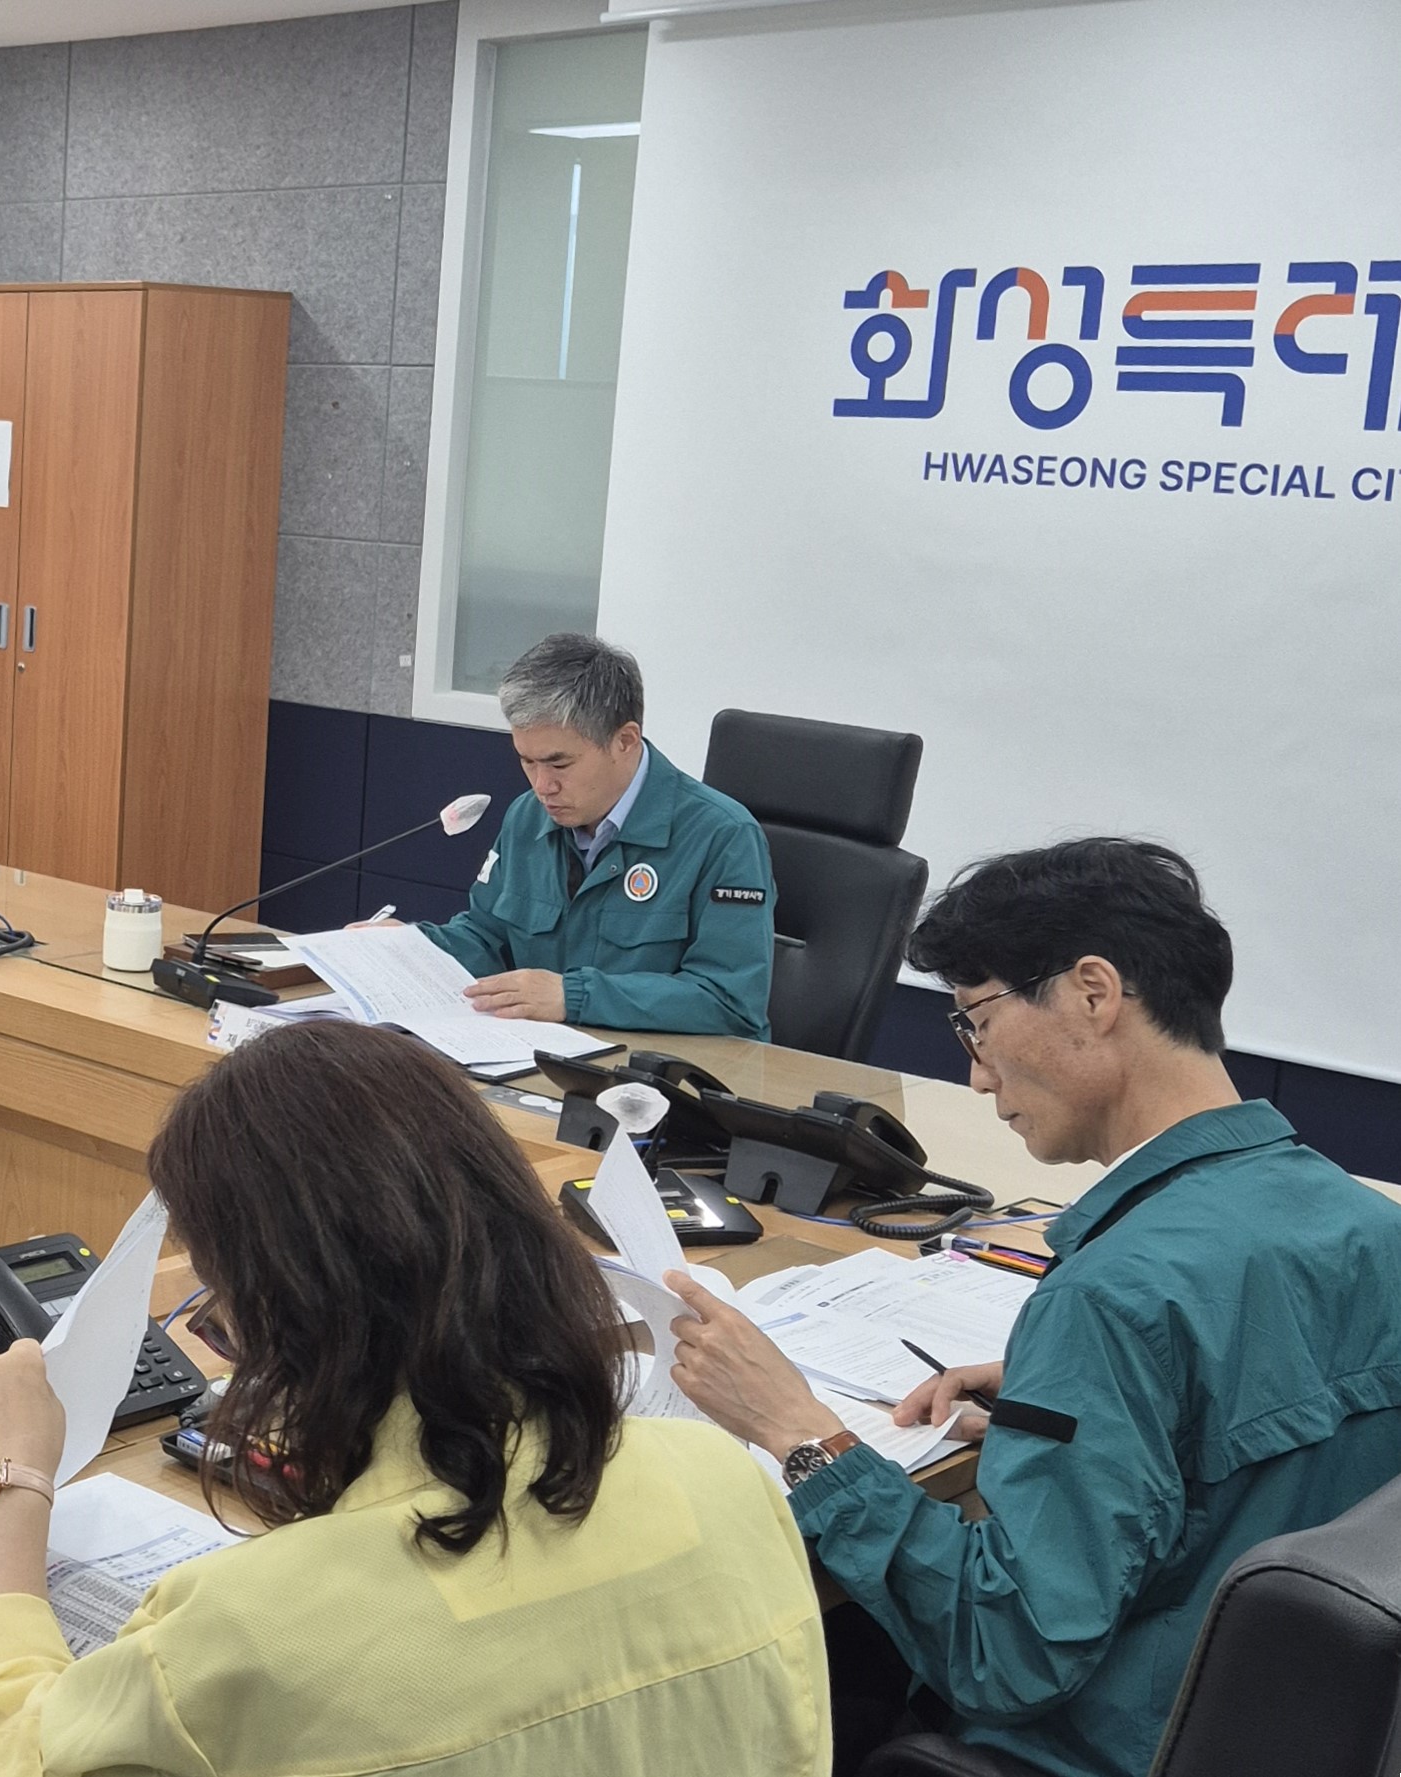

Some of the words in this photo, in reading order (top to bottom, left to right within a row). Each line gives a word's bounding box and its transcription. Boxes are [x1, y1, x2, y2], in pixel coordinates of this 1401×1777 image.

[923, 451, 1148, 490] HWASEONG
[1159, 459, 1336, 499] SPECIAL
[1351, 467, 1401, 502] CI
